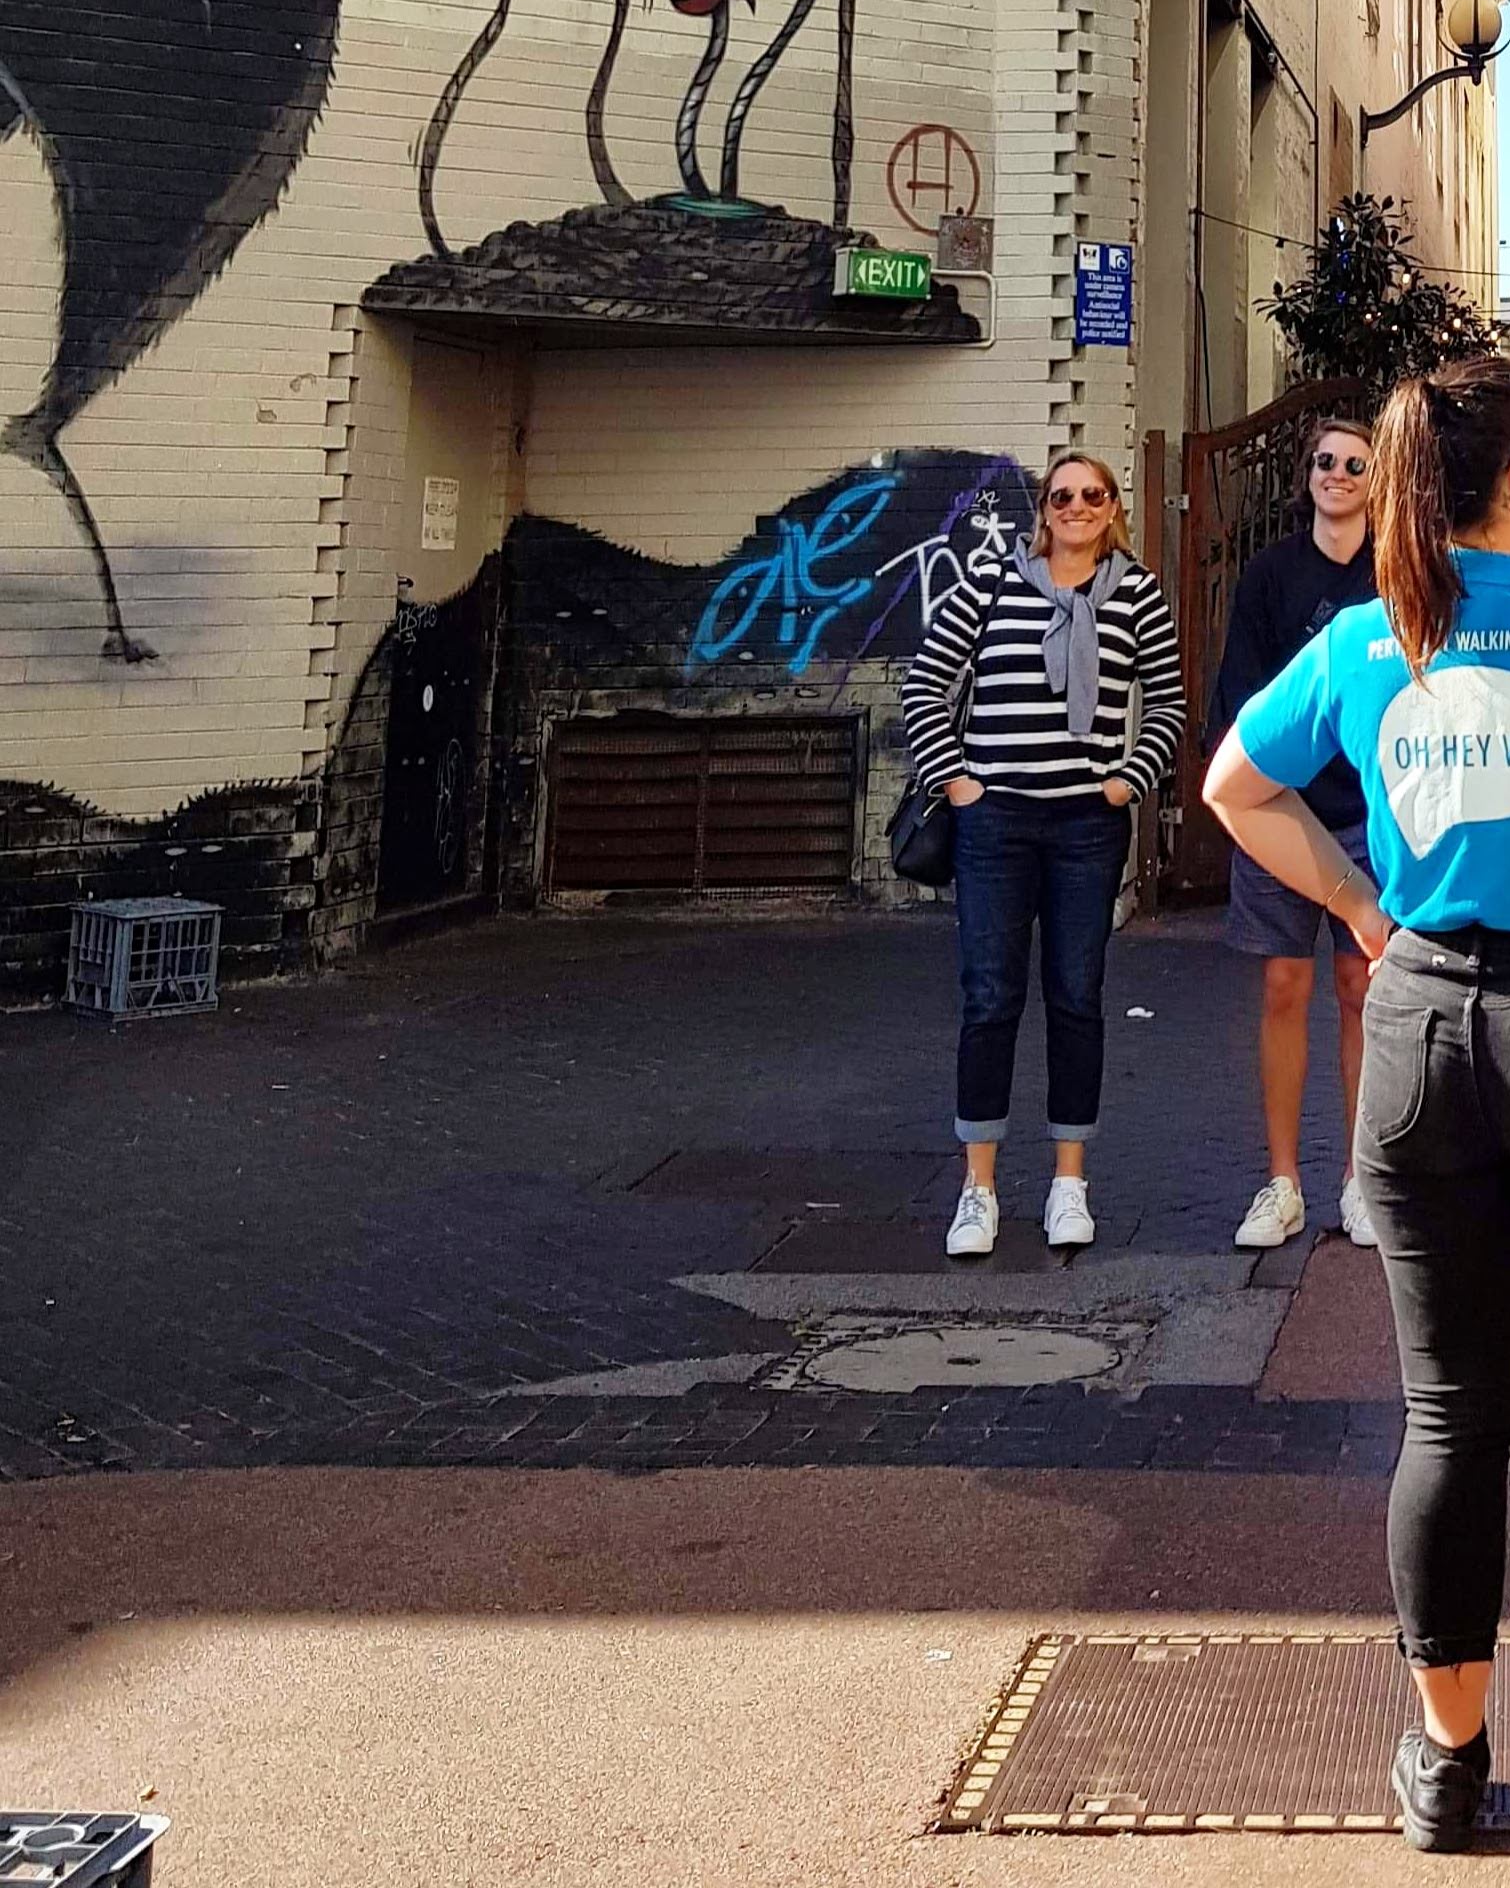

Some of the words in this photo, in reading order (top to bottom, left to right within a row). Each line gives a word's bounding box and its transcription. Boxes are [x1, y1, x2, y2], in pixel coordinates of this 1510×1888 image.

[868, 258, 916, 288] EXIT
[1395, 736, 1430, 769] OH
[1443, 733, 1491, 768] HEY
